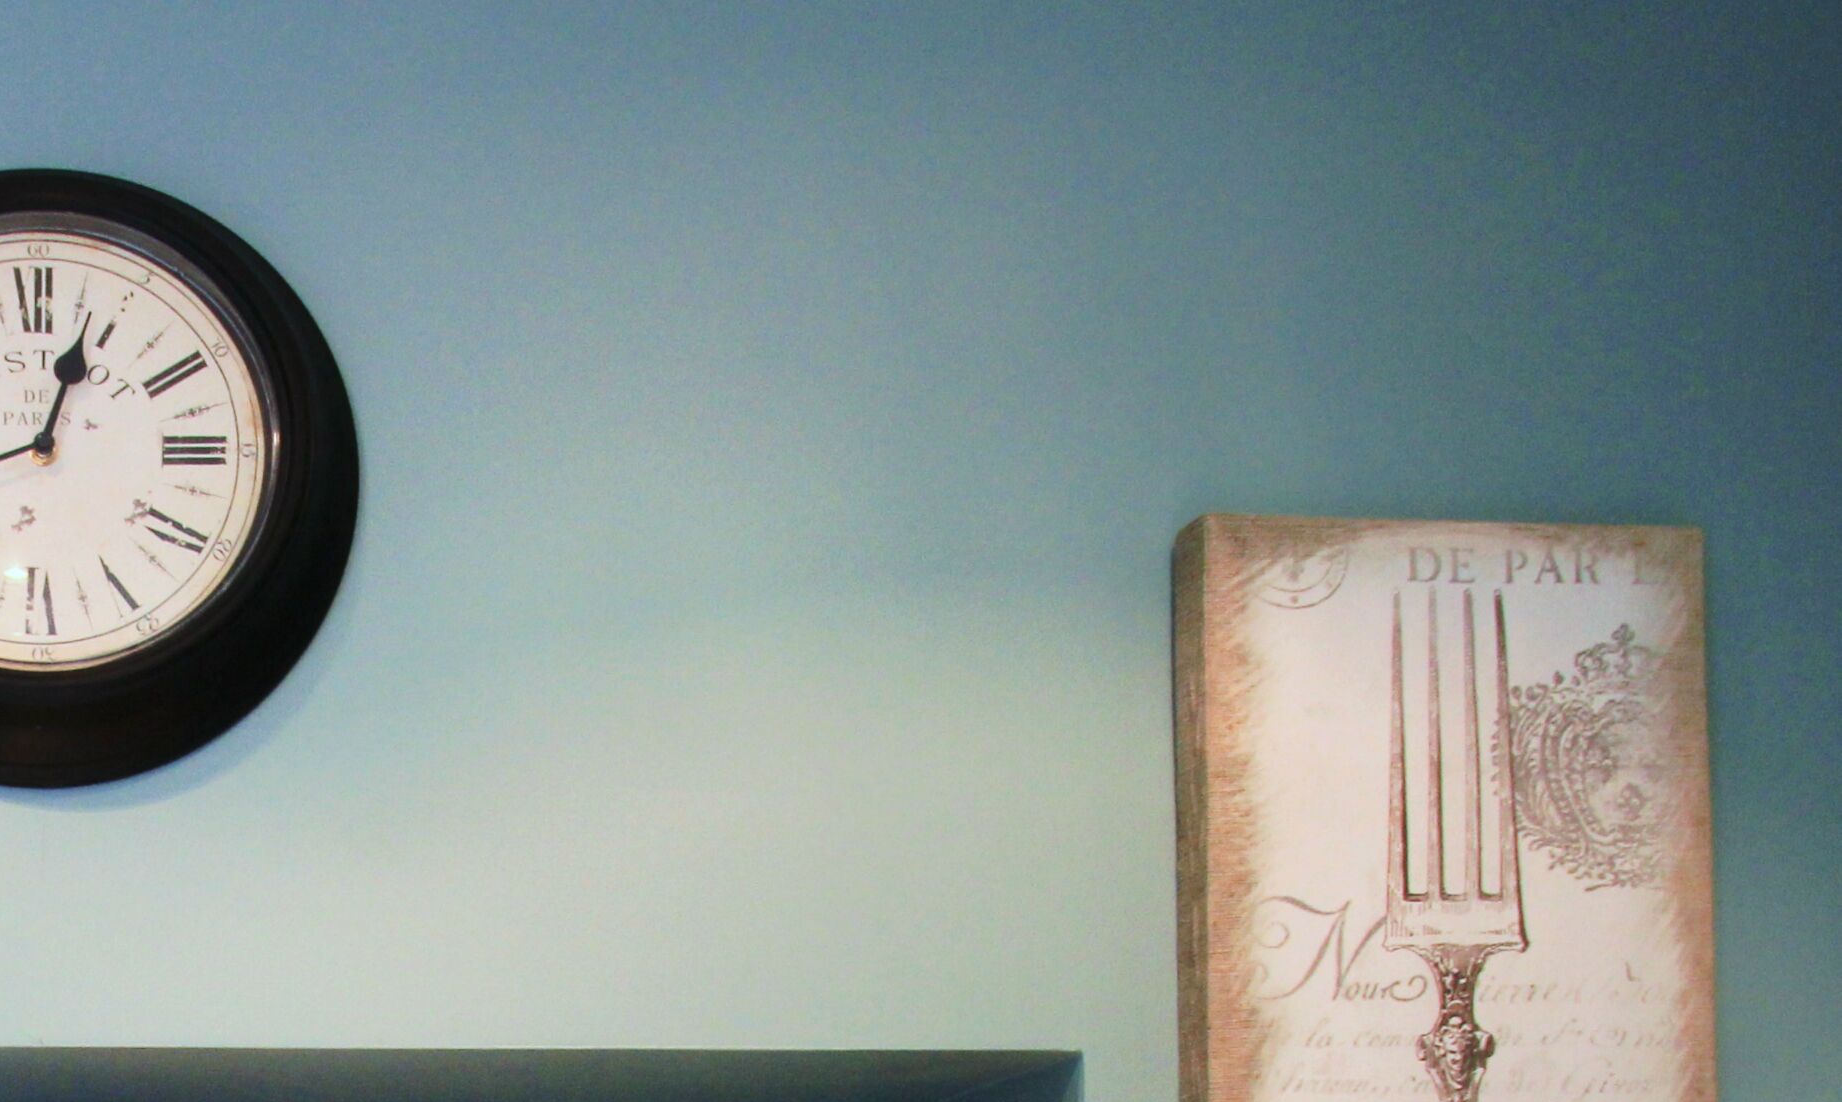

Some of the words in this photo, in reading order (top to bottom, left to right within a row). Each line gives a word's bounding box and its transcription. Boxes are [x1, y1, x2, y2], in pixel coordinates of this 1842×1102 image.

[27, 244, 50, 258] 60
[211, 337, 230, 359] 10
[142, 349, 208, 399] II
[24, 389, 50, 404] DE
[3, 411, 72, 426] PARS
[161, 434, 228, 468] III
[241, 442, 257, 459] 15
[212, 538, 233, 562] 20
[1407, 546, 1476, 583] DE
[1503, 547, 1600, 586] PAR
